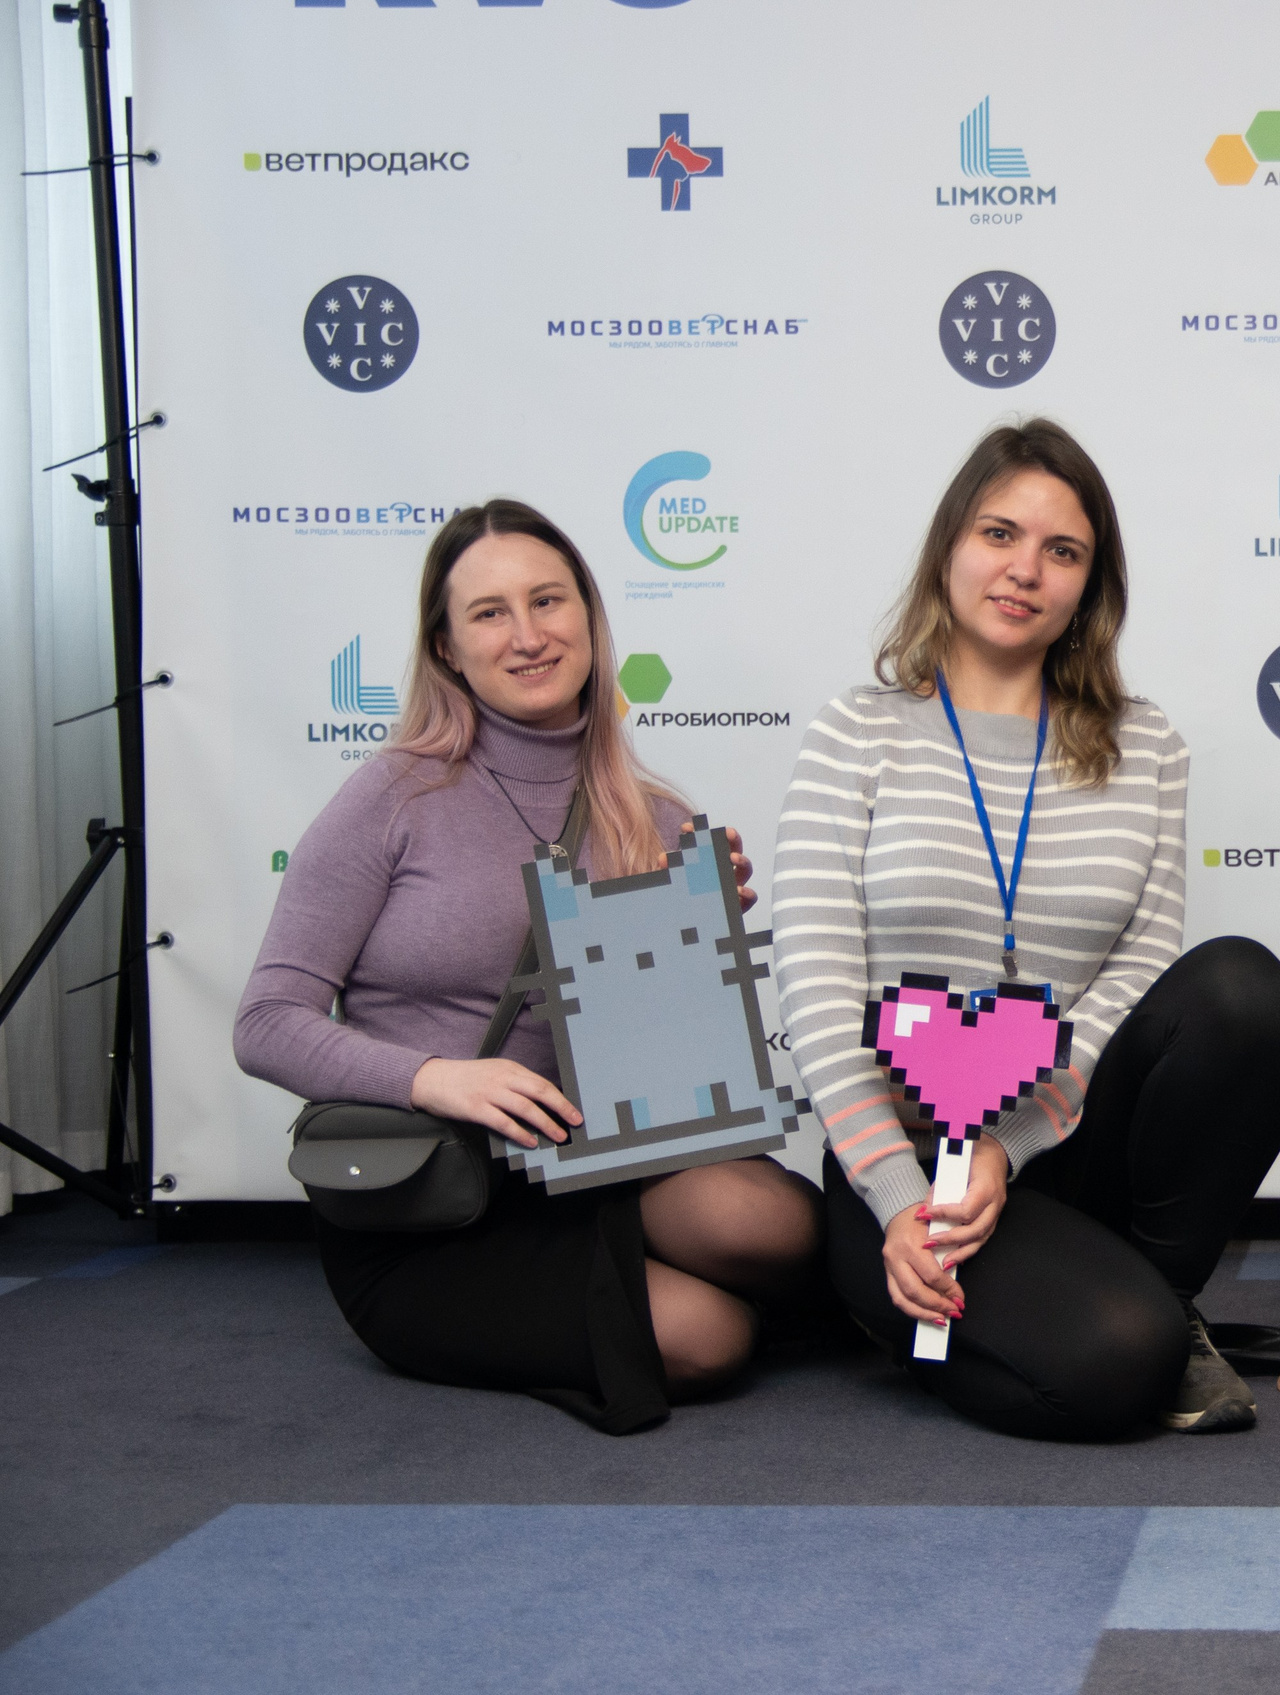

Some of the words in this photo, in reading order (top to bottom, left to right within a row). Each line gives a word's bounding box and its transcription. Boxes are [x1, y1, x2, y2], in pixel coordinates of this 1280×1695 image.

[264, 151, 470, 178] ветпродакс
[936, 185, 1057, 207] LIMKORM
[969, 212, 1024, 226] GROUP
[547, 316, 801, 336] МОСЗООВЕТСНАБ
[1244, 335, 1256, 343] МЫ
[233, 505, 461, 523] МОСЗООВЕТСН
[658, 497, 707, 515] MED
[295, 529, 308, 537] МЫ
[658, 515, 739, 534] UPDATE
[636, 711, 791, 727] АГРОБИОПРОМ
[308, 723, 396, 742] LIMKO
[341, 749, 373, 761] GRO
